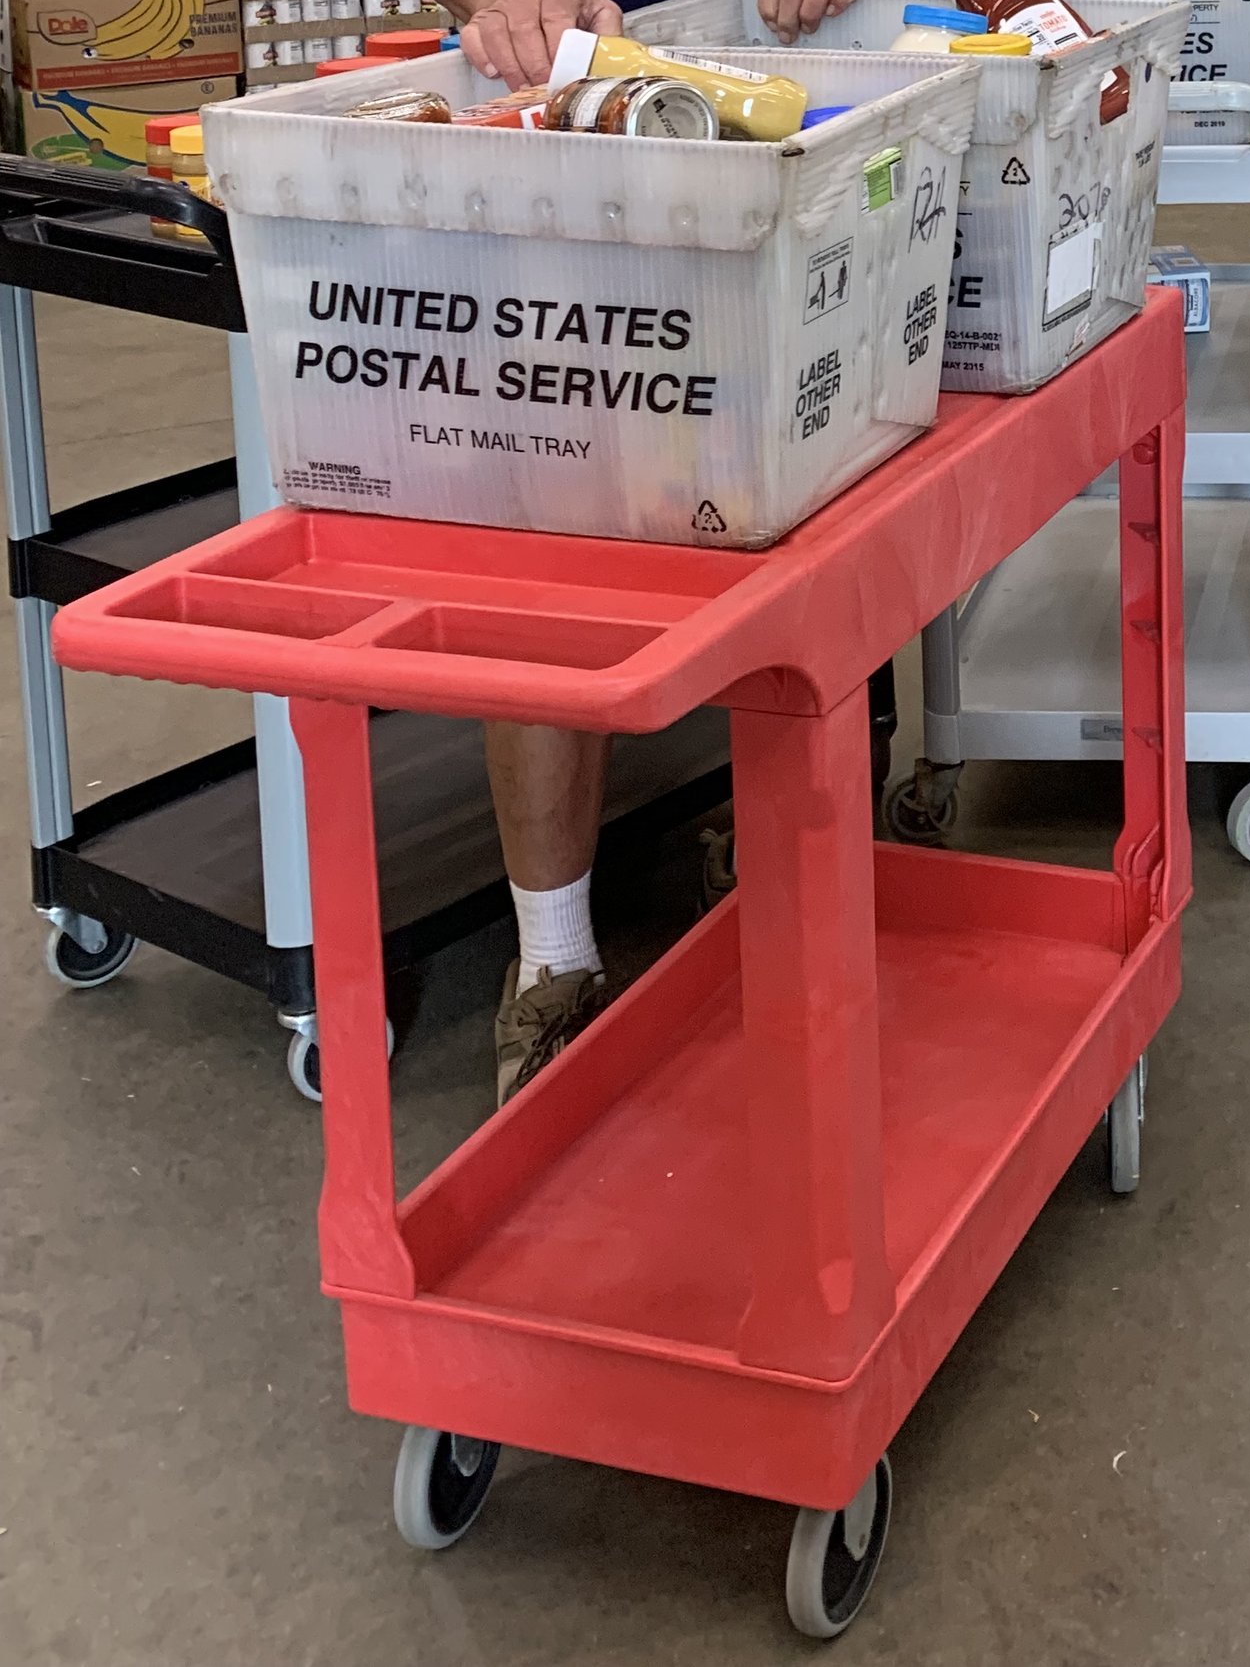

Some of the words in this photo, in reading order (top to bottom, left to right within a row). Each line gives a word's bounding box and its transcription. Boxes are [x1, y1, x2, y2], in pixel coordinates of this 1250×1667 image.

[48, 17, 88, 32] Dole
[189, 11, 237, 24] PREMIUM
[190, 23, 239, 37] BANANAS
[309, 280, 479, 334] UNITED
[494, 297, 691, 351] STATES
[905, 284, 938, 321] LABEL
[903, 307, 938, 345] OTHER
[908, 334, 929, 366] END
[295, 341, 480, 397] POSTAL
[496, 361, 717, 416] SERVICE
[798, 349, 842, 392] LABEL
[795, 373, 841, 418] OTHER
[802, 405, 830, 440] END
[410, 424, 463, 447] FLAT
[470, 430, 525, 453] MAIL
[530, 436, 591, 459] TRAY
[308, 462, 361, 475] WARNING
